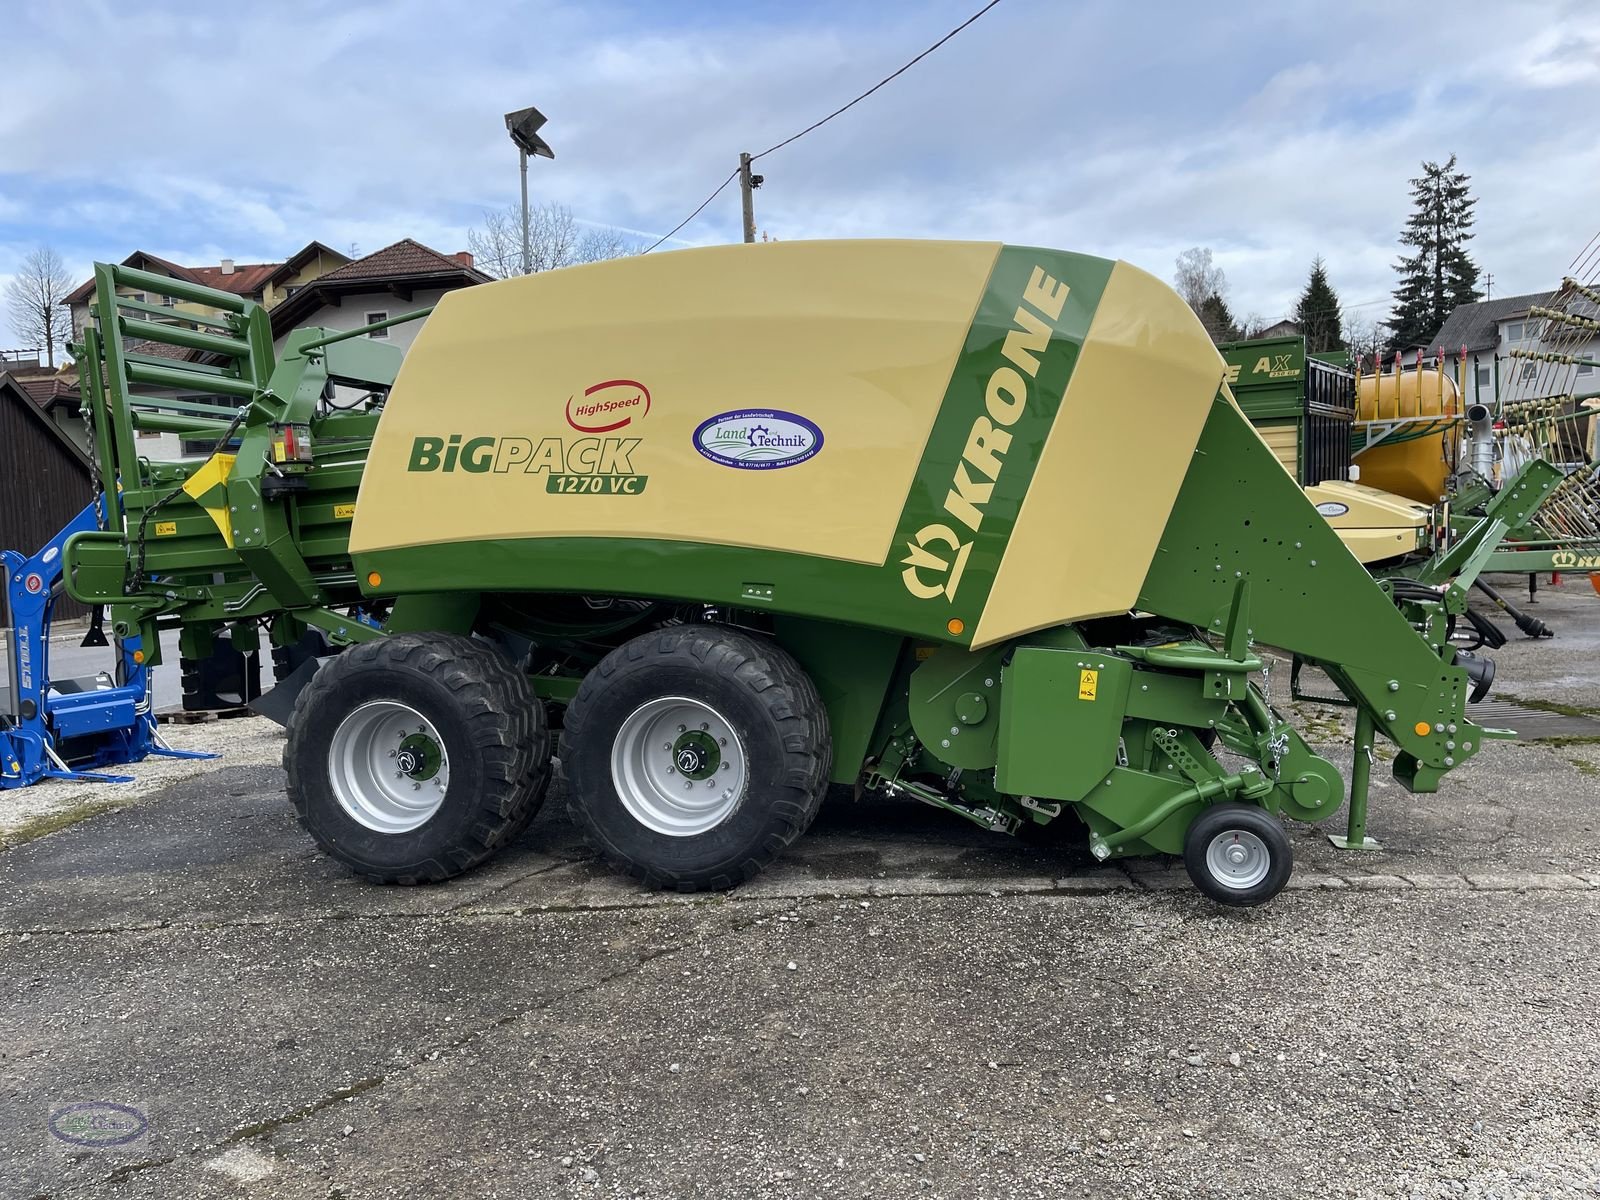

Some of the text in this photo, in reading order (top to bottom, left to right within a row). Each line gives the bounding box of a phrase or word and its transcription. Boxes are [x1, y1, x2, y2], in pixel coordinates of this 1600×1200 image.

[1252, 354, 1292, 374] AX
[575, 395, 641, 417] HighSpeed
[944, 265, 1070, 533] KRONE
[715, 427, 747, 440] Land
[757, 435, 806, 447] Technik
[556, 477, 638, 493] 1270 VC
